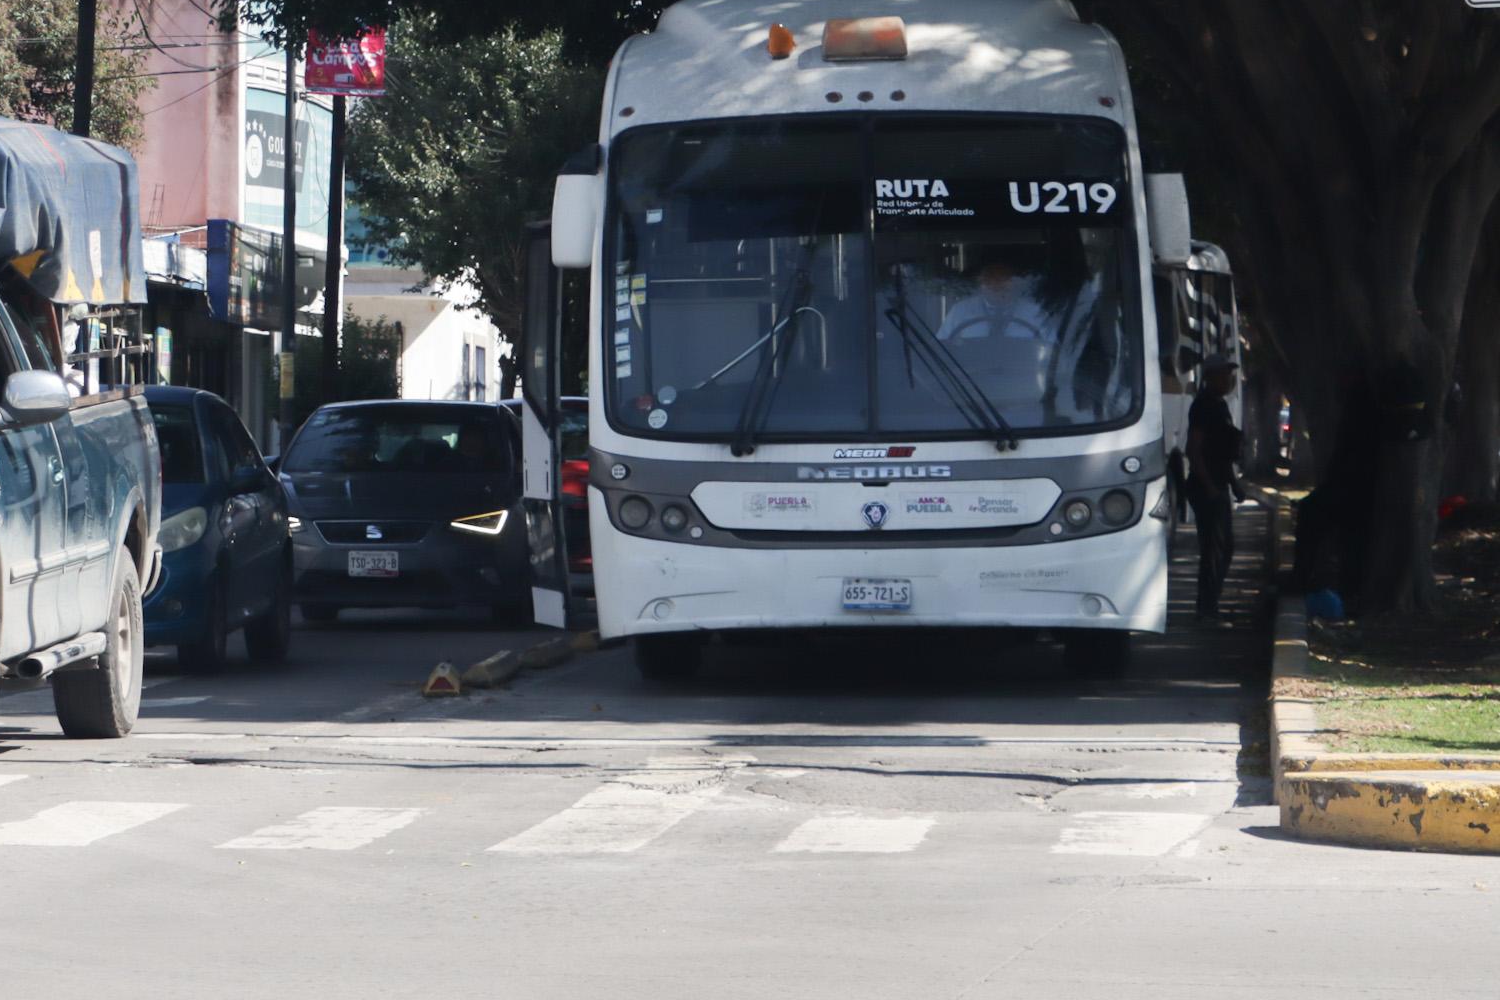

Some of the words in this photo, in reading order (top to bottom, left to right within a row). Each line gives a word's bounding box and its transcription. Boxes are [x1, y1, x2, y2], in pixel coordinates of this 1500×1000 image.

[875, 179, 950, 198] RUTA
[876, 199, 895, 208] Red
[931, 200, 944, 208] de
[1008, 181, 1117, 214] U219
[877, 207, 927, 216] Tranorte
[928, 207, 975, 216] Articulado
[797, 465, 951, 479] NEOBUS
[918, 496, 946, 504] AMOR
[906, 503, 953, 513] PUEBLA
[844, 586, 909, 601] 655-721-S
